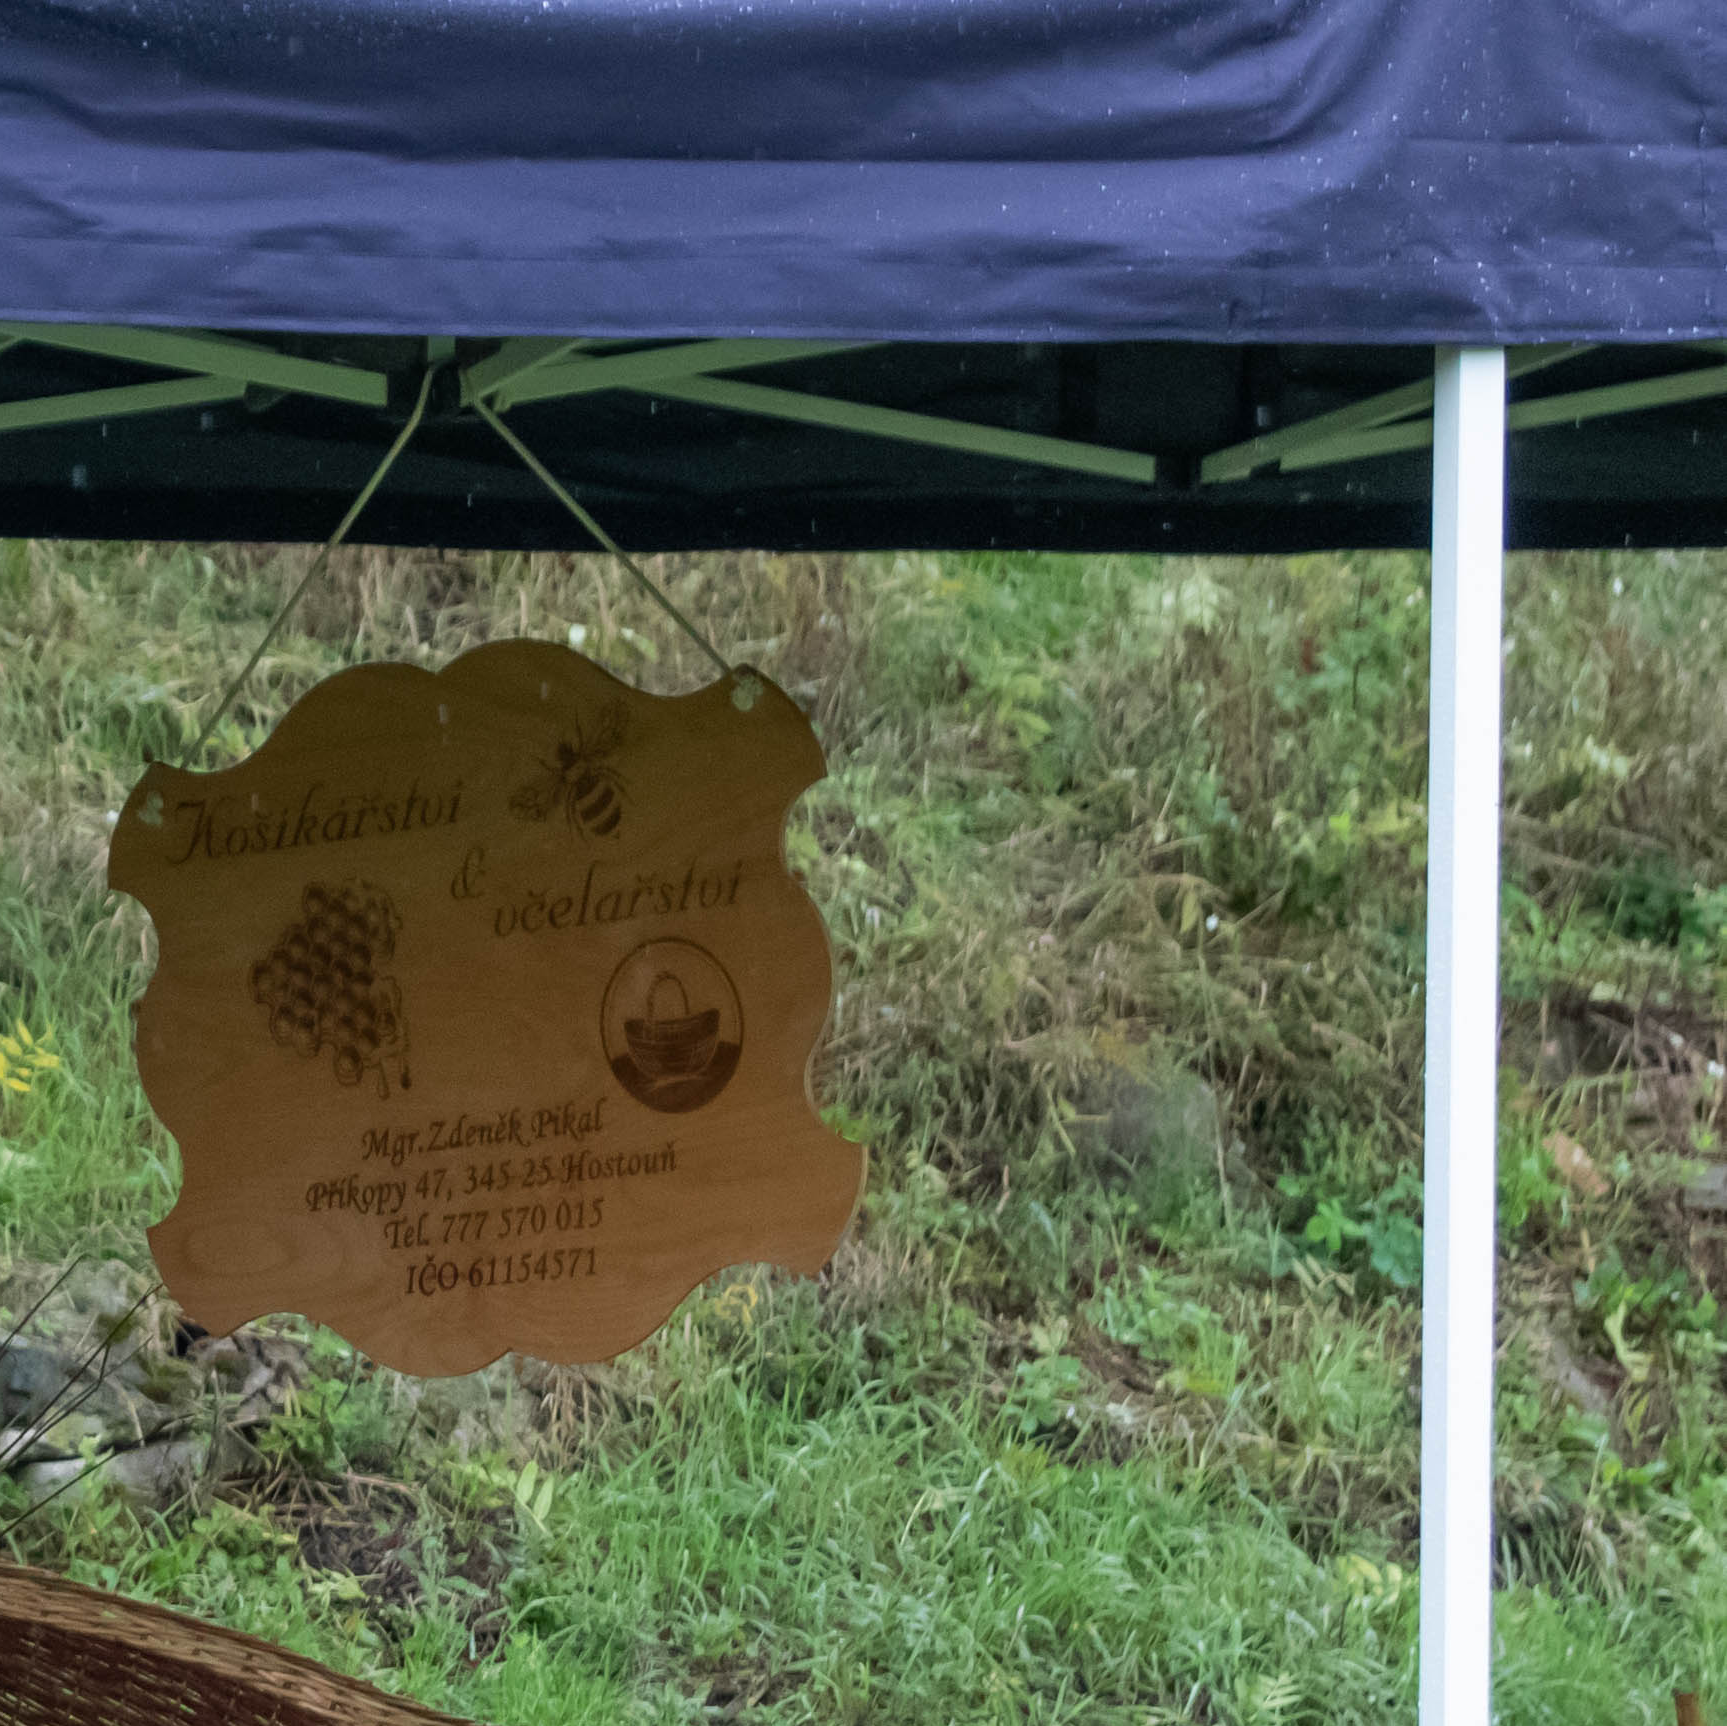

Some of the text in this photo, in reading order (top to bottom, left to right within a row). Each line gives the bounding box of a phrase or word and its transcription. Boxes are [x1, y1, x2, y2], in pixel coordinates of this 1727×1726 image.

[450, 844, 486, 901] &
[532, 1097, 607, 1142] Pikal
[305, 1141, 678, 1215] Příkopy 47, 345 25 Hostouň
[443, 1210, 489, 1243] 777
[498, 1204, 546, 1239] 570
[555, 1197, 605, 1232] 015
[405, 1247, 597, 1297] IČO 61154571
